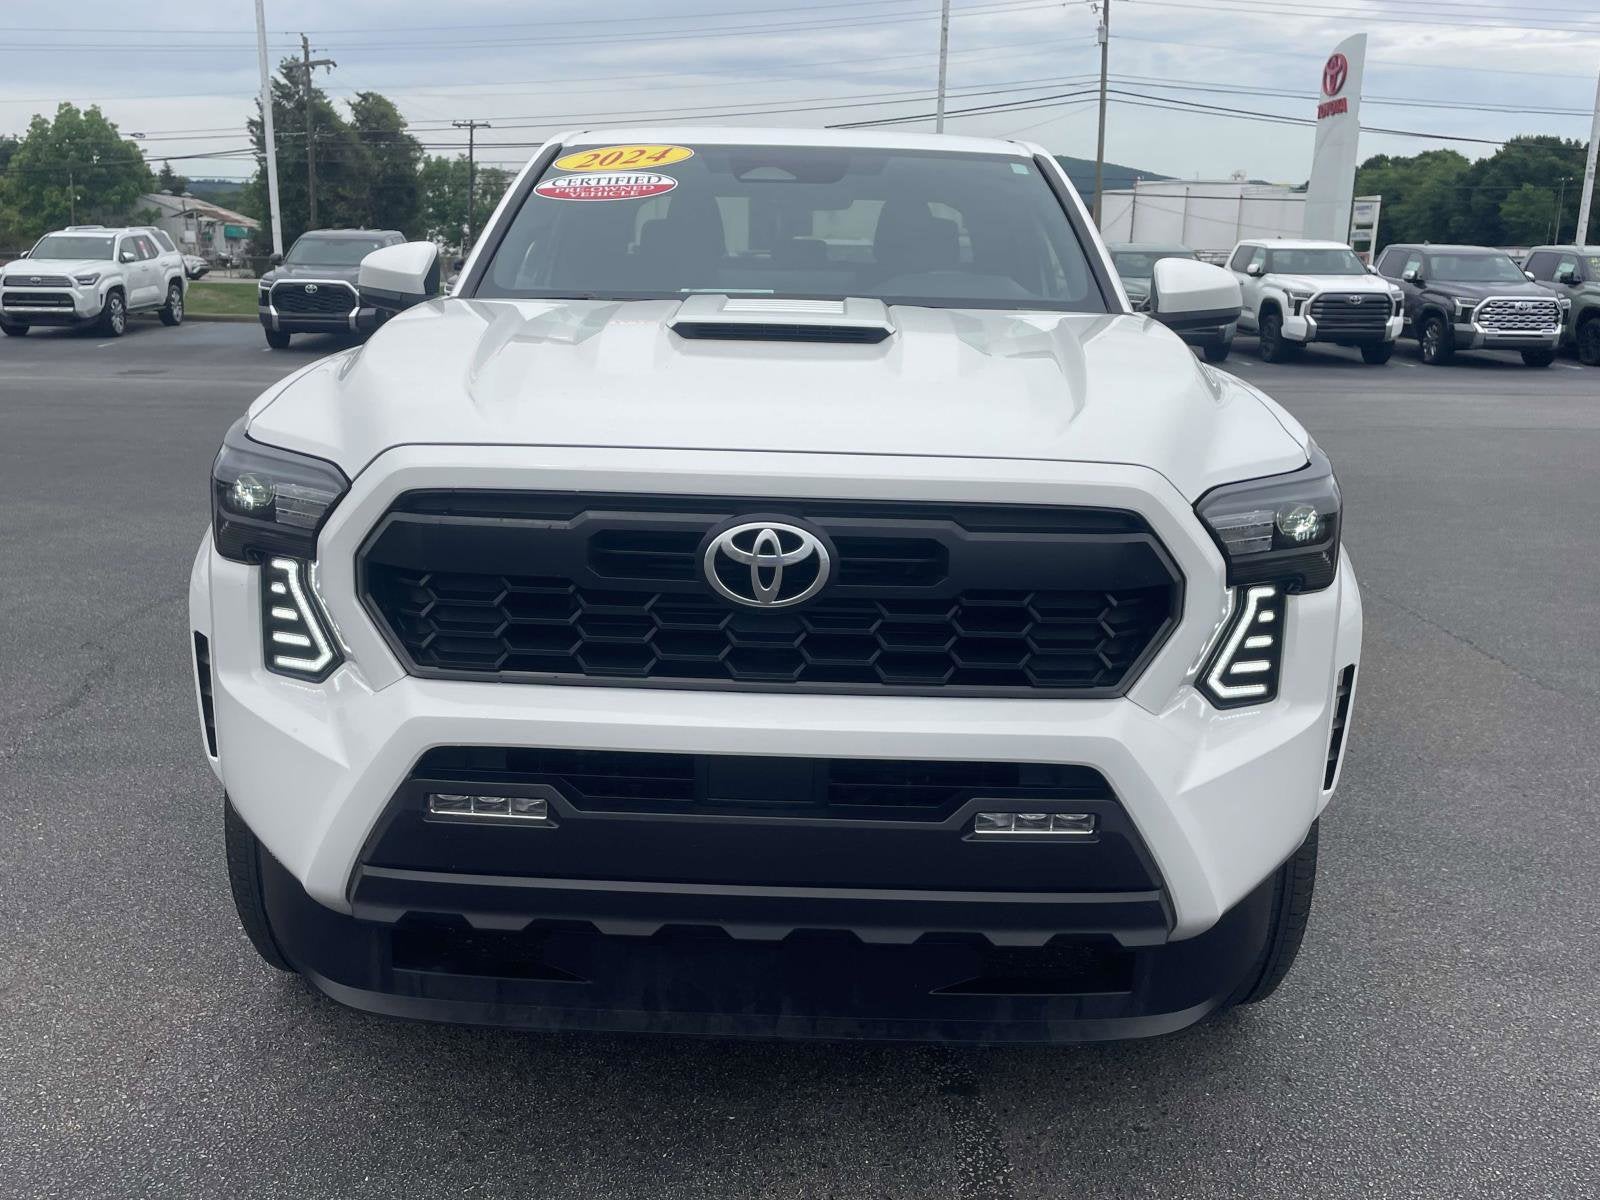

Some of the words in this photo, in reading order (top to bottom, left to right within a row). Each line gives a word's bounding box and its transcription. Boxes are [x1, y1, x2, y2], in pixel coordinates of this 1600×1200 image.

[575, 148, 673, 168] 2024
[552, 175, 662, 187] CERTIFIED
[555, 185, 655, 194] PRE-OWNED
[570, 190, 639, 198] VEHICLE
